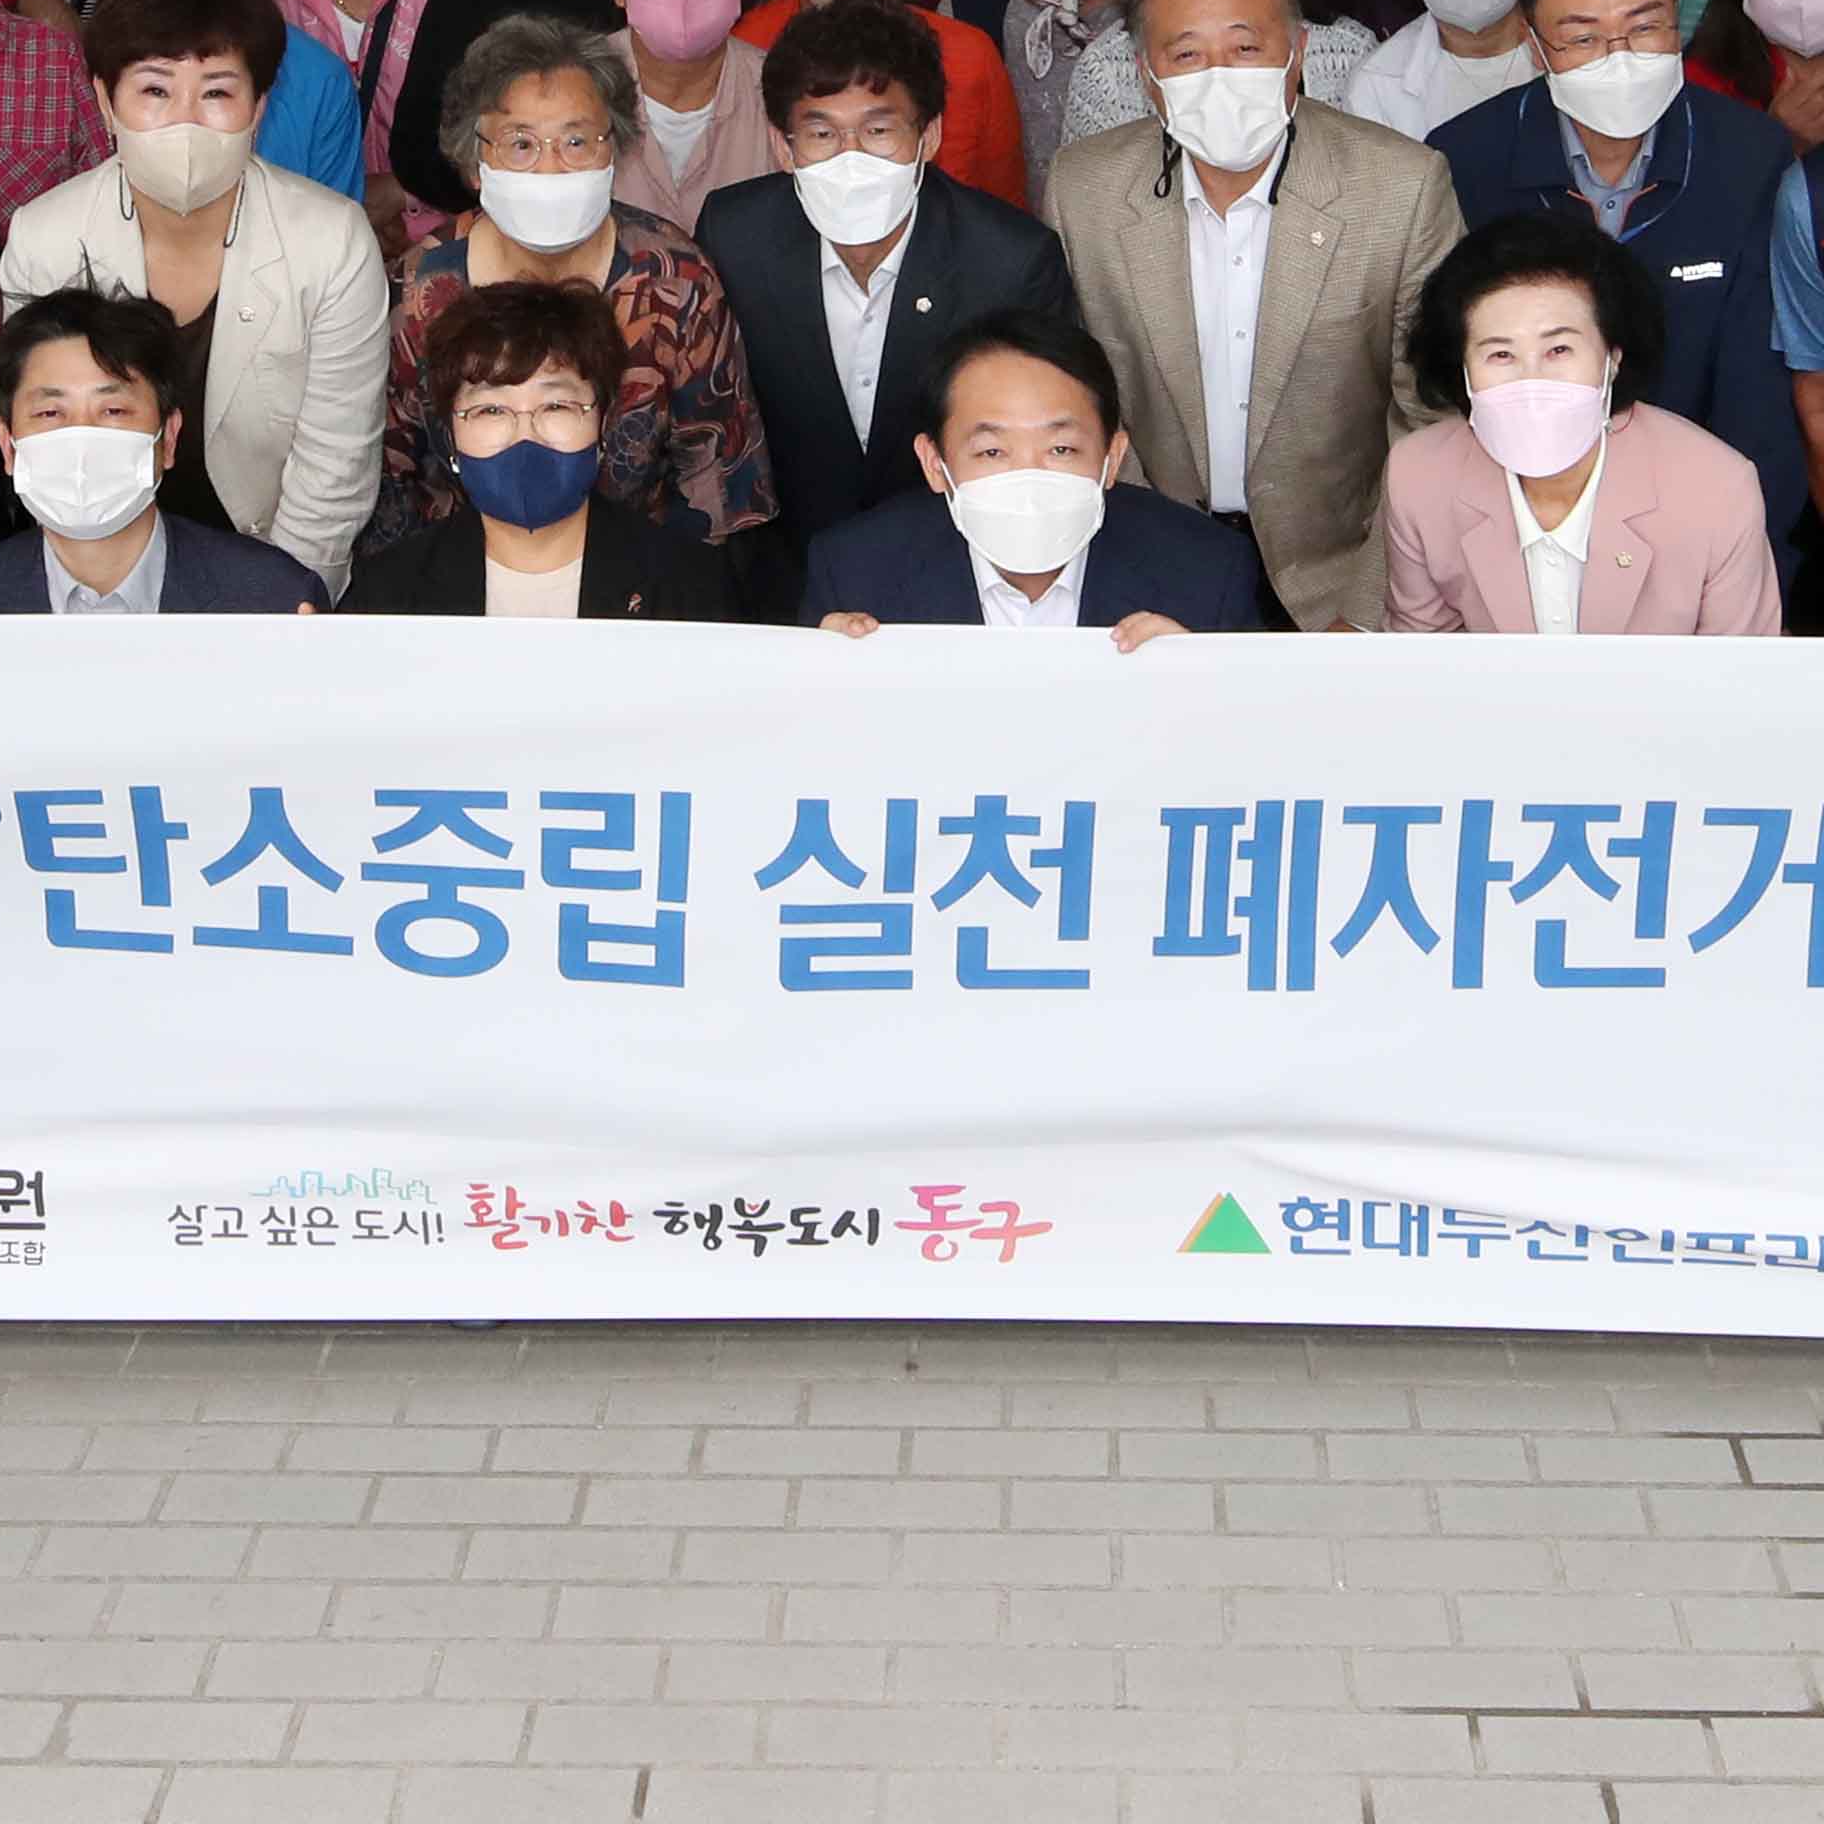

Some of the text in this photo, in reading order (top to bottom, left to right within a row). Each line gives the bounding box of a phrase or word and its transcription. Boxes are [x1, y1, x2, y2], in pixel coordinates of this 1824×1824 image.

[754, 794, 1095, 991] 실천
[167, 1204, 250, 1246] 살고
[260, 1204, 340, 1246] 싶은
[351, 1212, 446, 1246] 도시!
[463, 1183, 635, 1250] 활기찬
[893, 1184, 1054, 1263] 동구
